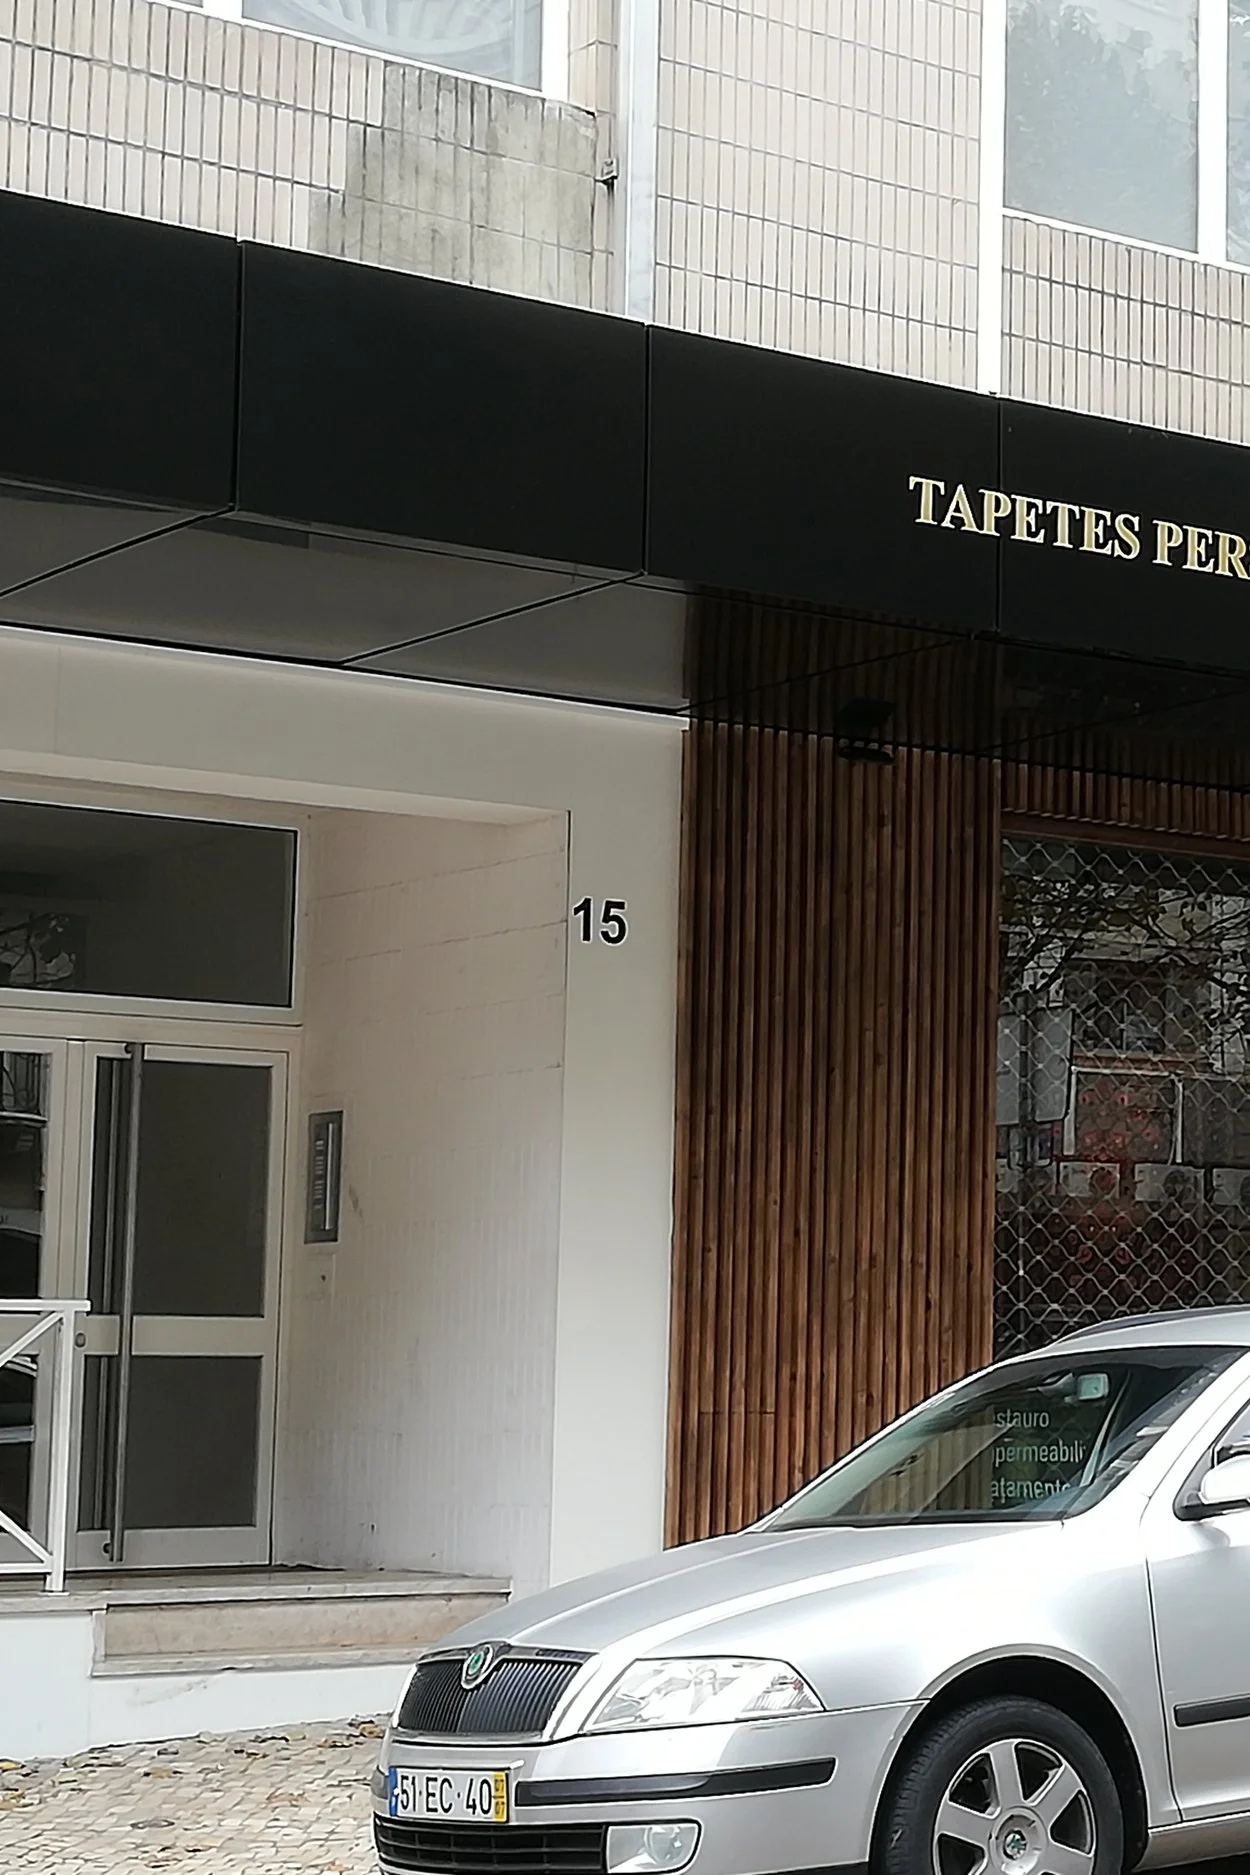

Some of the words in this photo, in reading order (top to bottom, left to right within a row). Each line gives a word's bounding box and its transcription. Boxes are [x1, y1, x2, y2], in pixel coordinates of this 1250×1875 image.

[909, 476, 1140, 559] TAPETES
[573, 897, 627, 944] 15
[993, 1408, 1050, 1428] stauro
[992, 1438, 1086, 1467] permeabili
